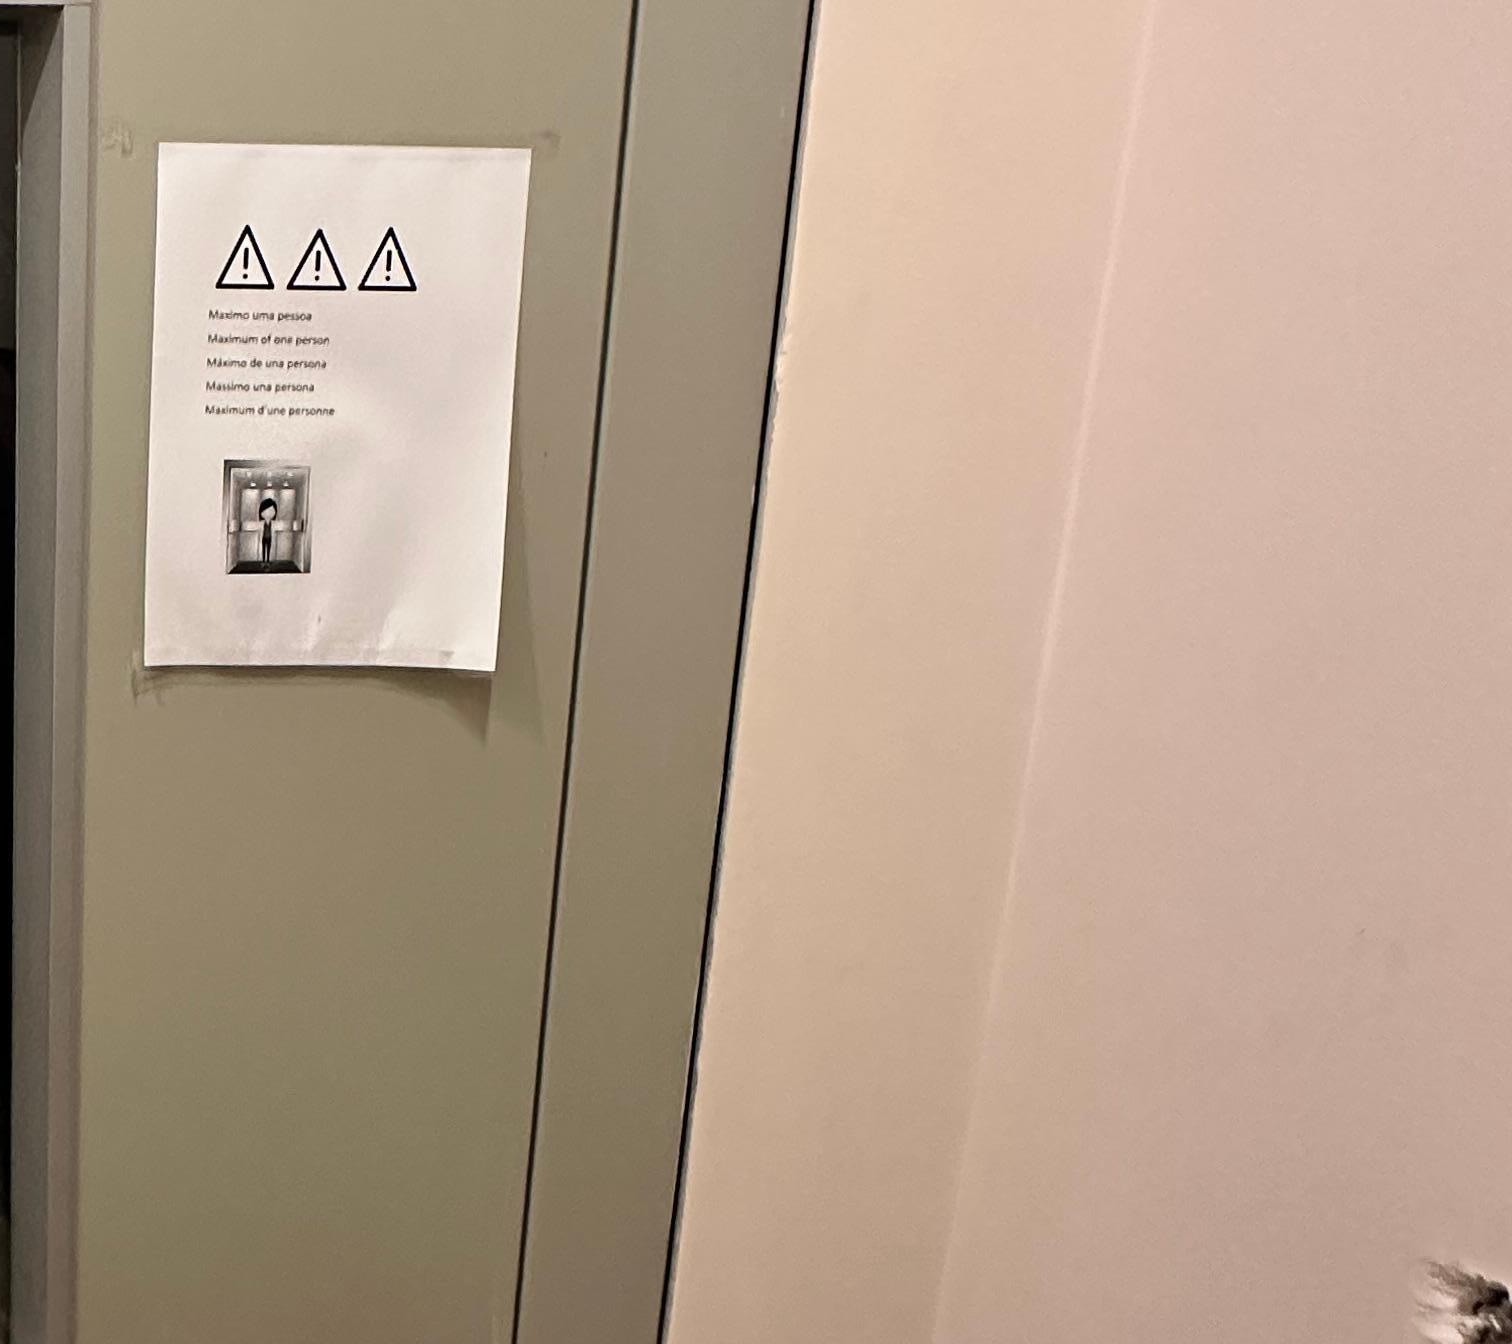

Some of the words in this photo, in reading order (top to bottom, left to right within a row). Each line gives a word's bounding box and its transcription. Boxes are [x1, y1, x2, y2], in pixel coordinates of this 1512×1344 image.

[252, 312, 275, 321] uma
[277, 312, 312, 322] pessoa
[207, 334, 258, 344] Maximum
[261, 333, 272, 344] of
[274, 336, 293, 344] one
[296, 336, 329, 346] person
[206, 358, 247, 368] Máximo
[250, 358, 262, 368] de
[265, 360, 284, 368] una
[287, 360, 327, 370] persona
[205, 381, 250, 392] Massimo
[253, 383, 272, 391] una
[275, 383, 314, 393] persona
[205, 405, 255, 415] Maximum
[289, 407, 335, 417] personne
